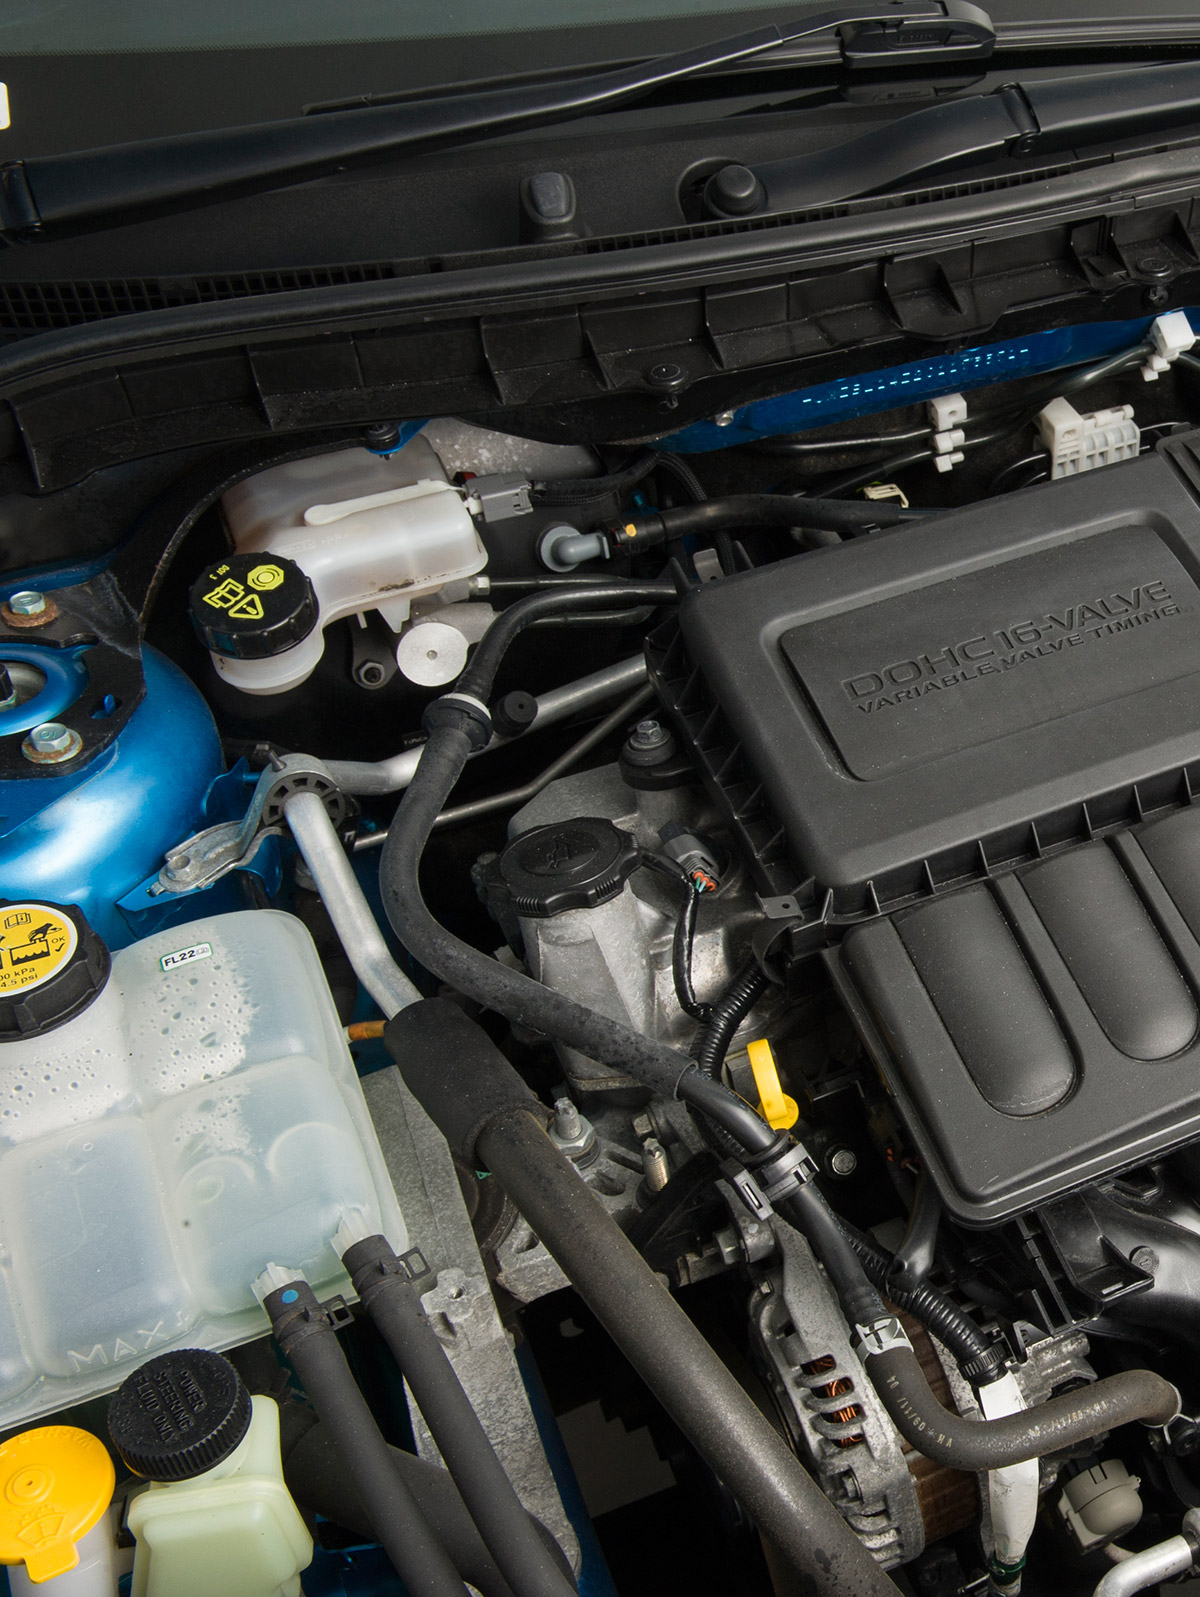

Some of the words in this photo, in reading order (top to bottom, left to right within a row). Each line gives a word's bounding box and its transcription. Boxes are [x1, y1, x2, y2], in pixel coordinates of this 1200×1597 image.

[840, 635, 996, 701] DOHC
[993, 580, 1172, 651] 16-VALVE
[856, 660, 1003, 715] VARIABLE
[1000, 633, 1086, 670] VALVE
[1086, 603, 1183, 640] TIMING
[13, 967, 36, 977] kPa
[20, 973, 38, 984] psi
[163, 949, 197, 967] FL22
[67, 1320, 170, 1372] MAX
[134, 1375, 161, 1414] FLUID
[153, 1414, 179, 1444] ONLY
[153, 1370, 194, 1432] STEERING
[179, 1370, 206, 1414] POWER
[19, 1428, 93, 1449] WASHER
